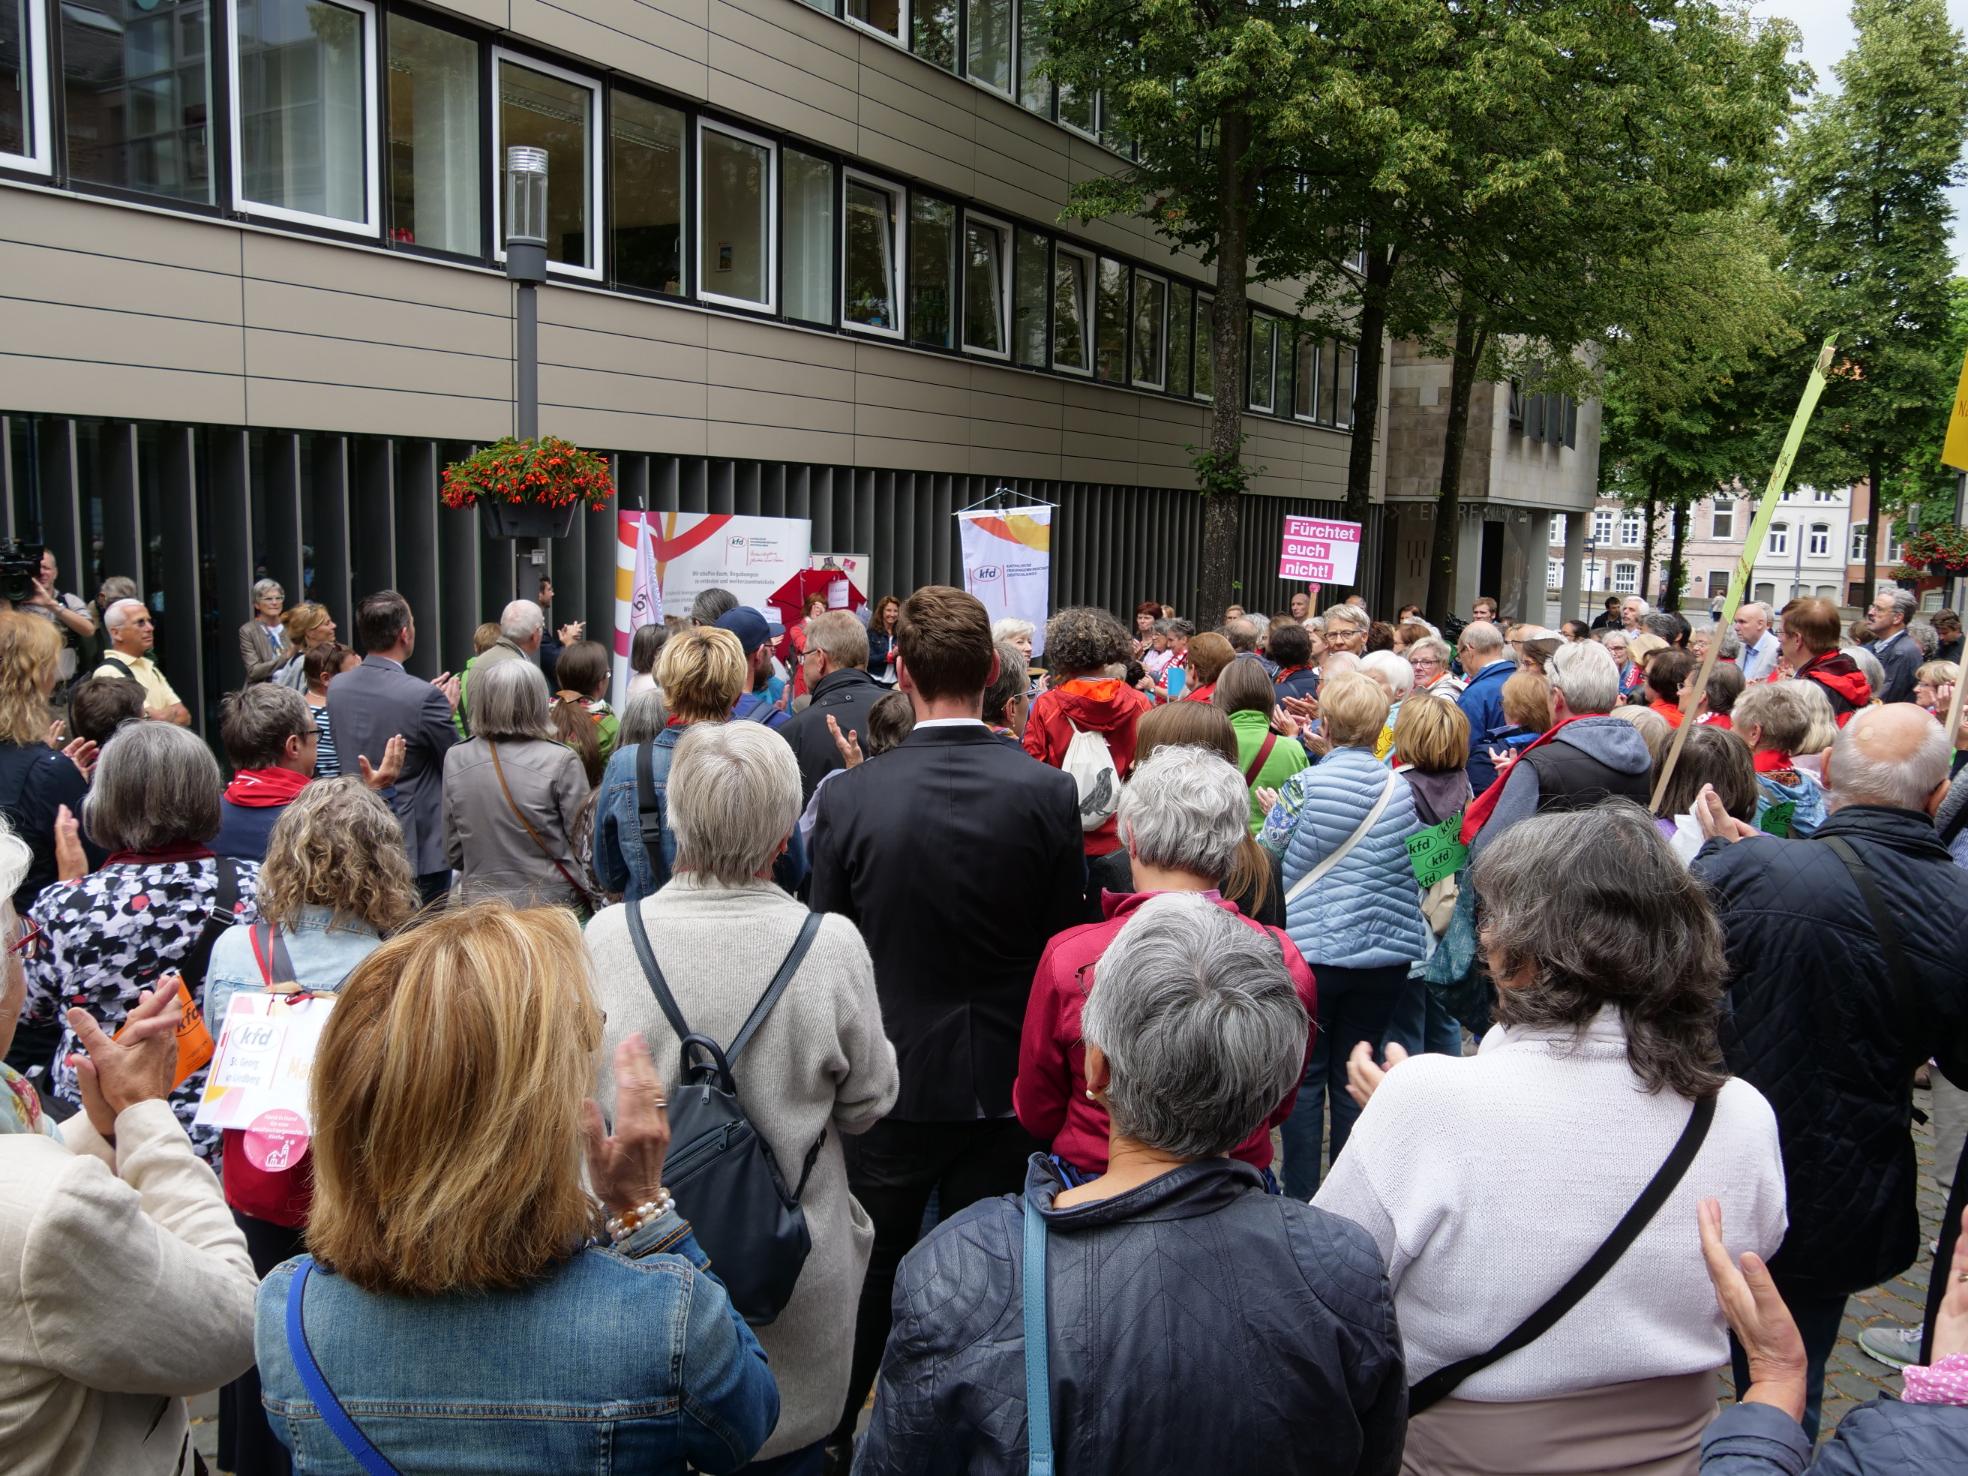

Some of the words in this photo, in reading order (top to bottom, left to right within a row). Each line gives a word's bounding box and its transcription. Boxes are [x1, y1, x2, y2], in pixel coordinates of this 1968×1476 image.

[1290, 521, 1355, 540] Fürchtet
[1287, 544, 1325, 557] euch
[979, 568, 996, 579] kfd
[1285, 562, 1328, 578] nicht!
[1440, 817, 1454, 835] kfd
[1408, 838, 1430, 854] kfd
[1431, 850, 1449, 866] kfd
[240, 1026, 273, 1046] kfd
